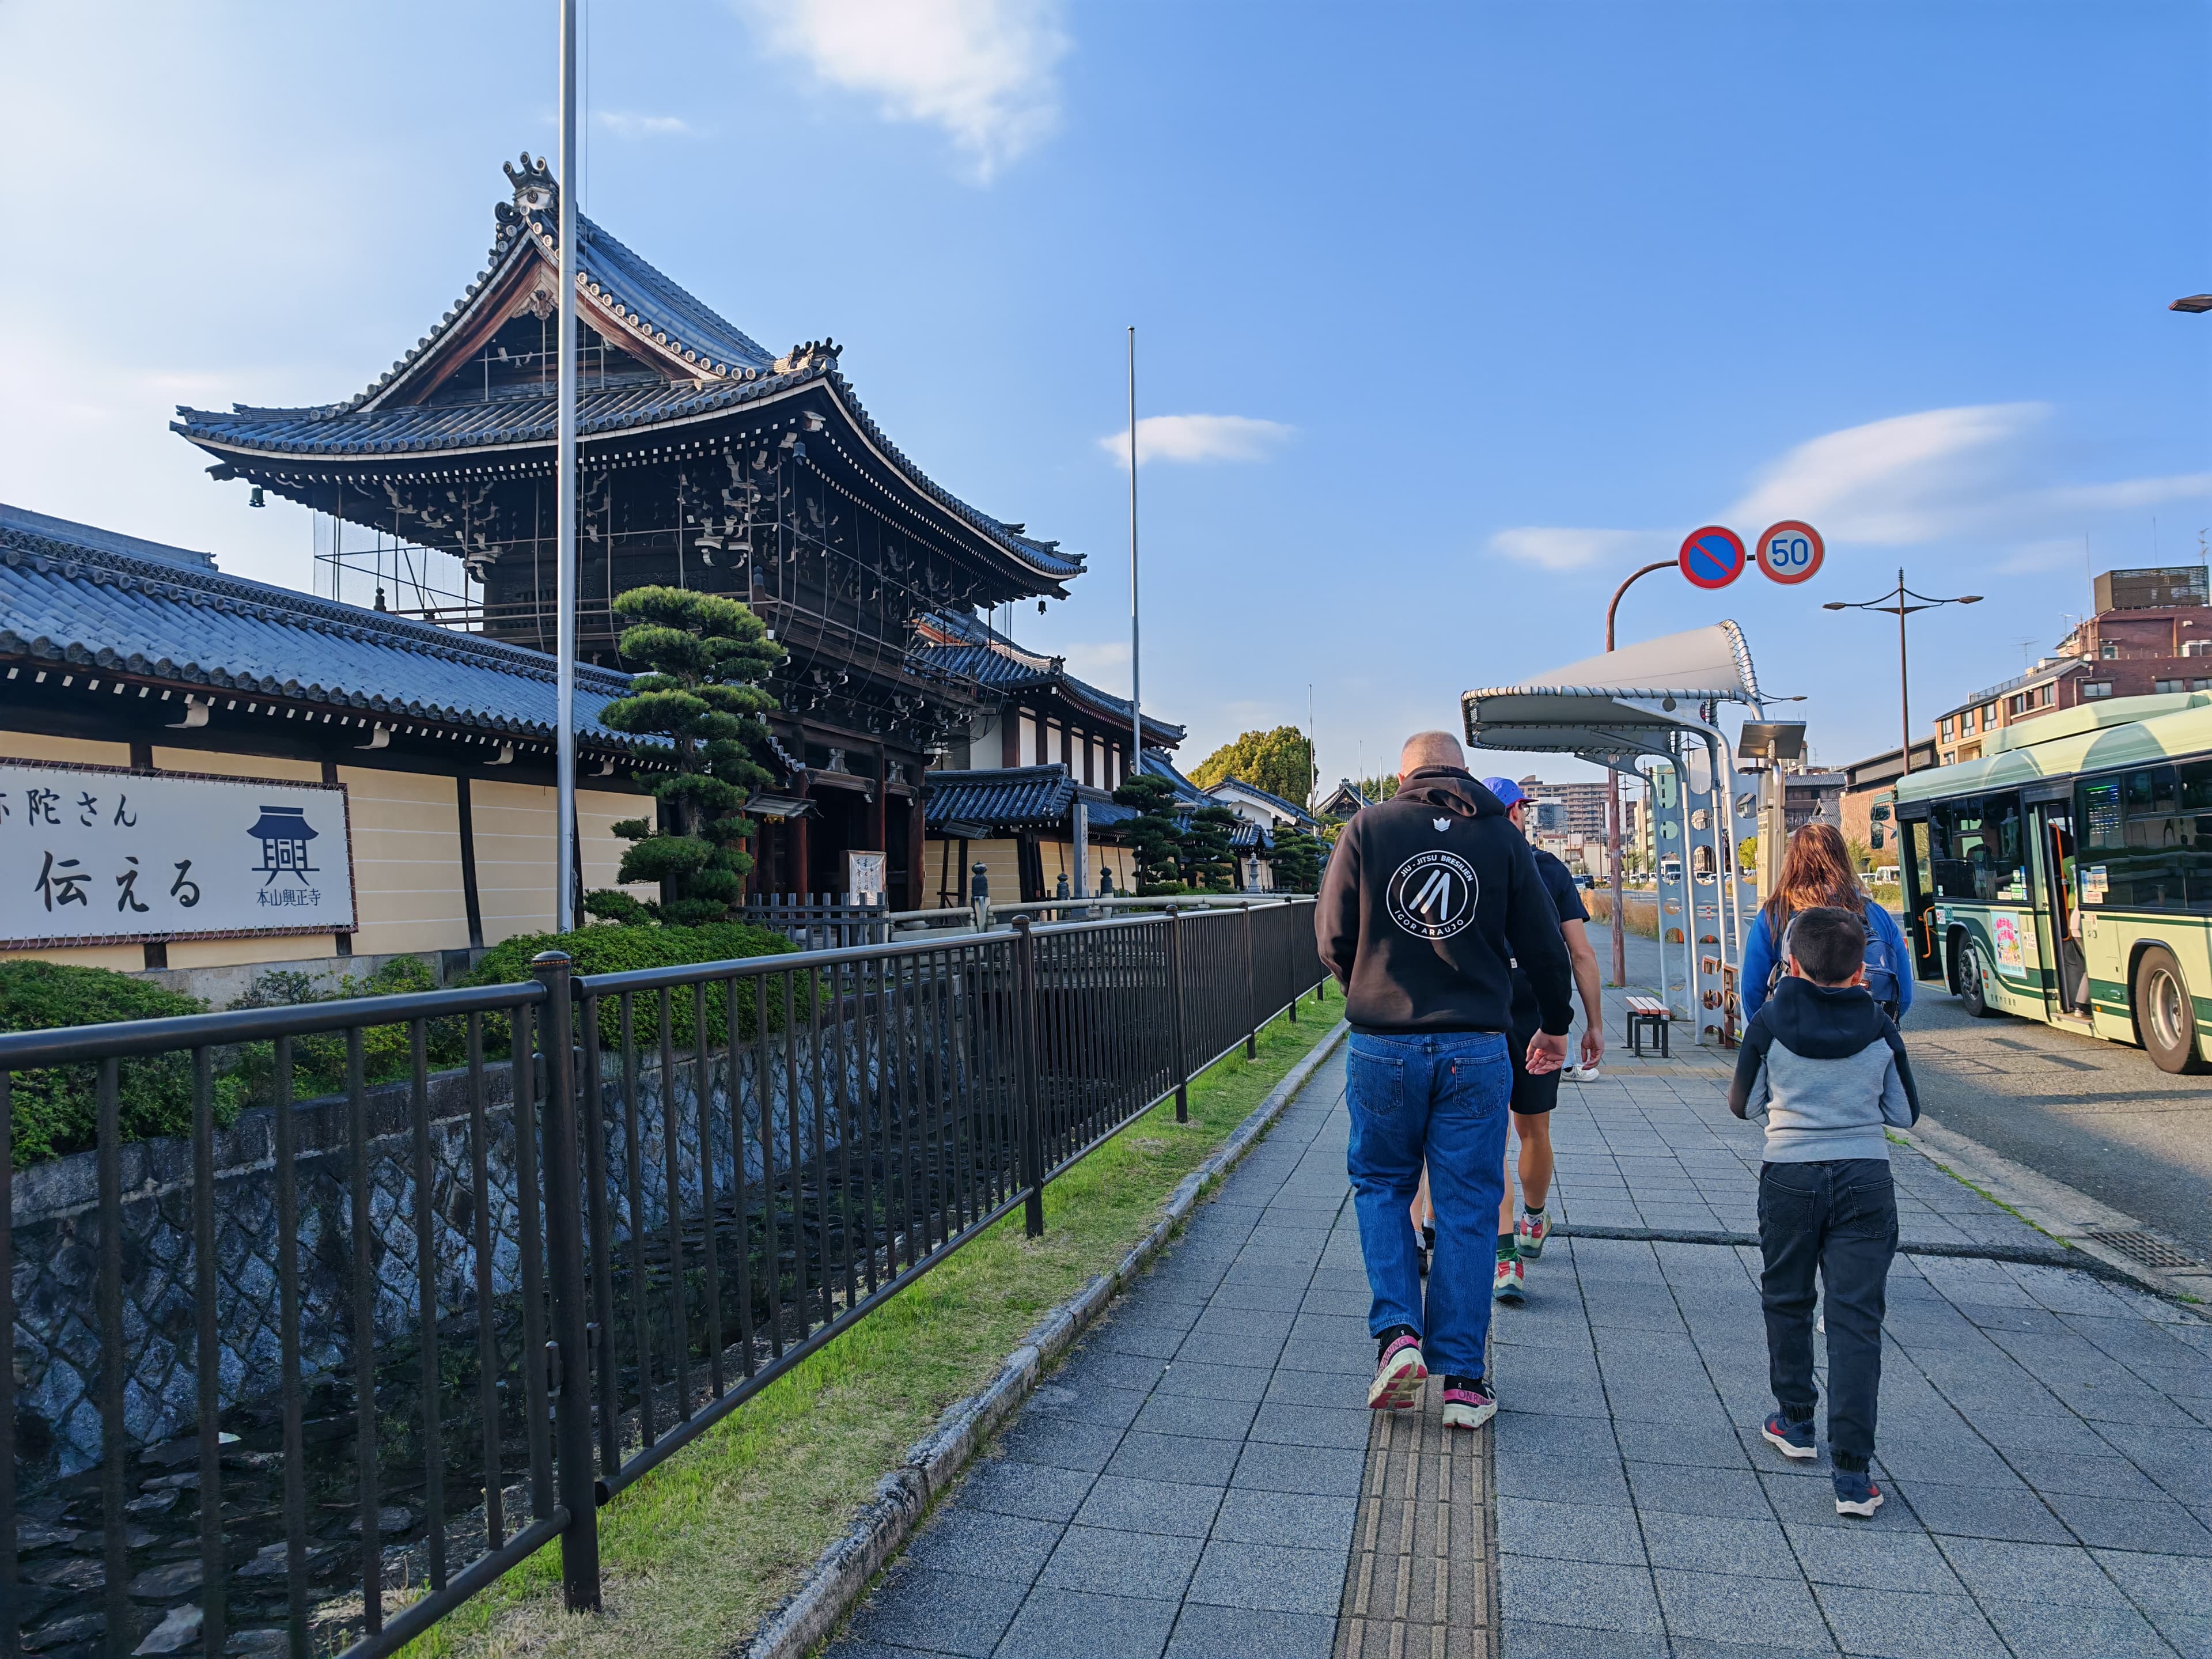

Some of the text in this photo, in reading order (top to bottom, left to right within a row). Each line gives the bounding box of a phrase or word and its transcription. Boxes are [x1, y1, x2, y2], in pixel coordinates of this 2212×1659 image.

[1772, 538, 1808, 567] 50
[34, 850, 200, 912] 伝える
[1441, 855, 1474, 882] BRESILIEN
[256, 888, 321, 907] 本山興正寺
[1394, 910, 1464, 935] IGOR ARAUJO
[1380, 1337, 1407, 1373] RUNNING
[1458, 1390, 1472, 1401] ON
